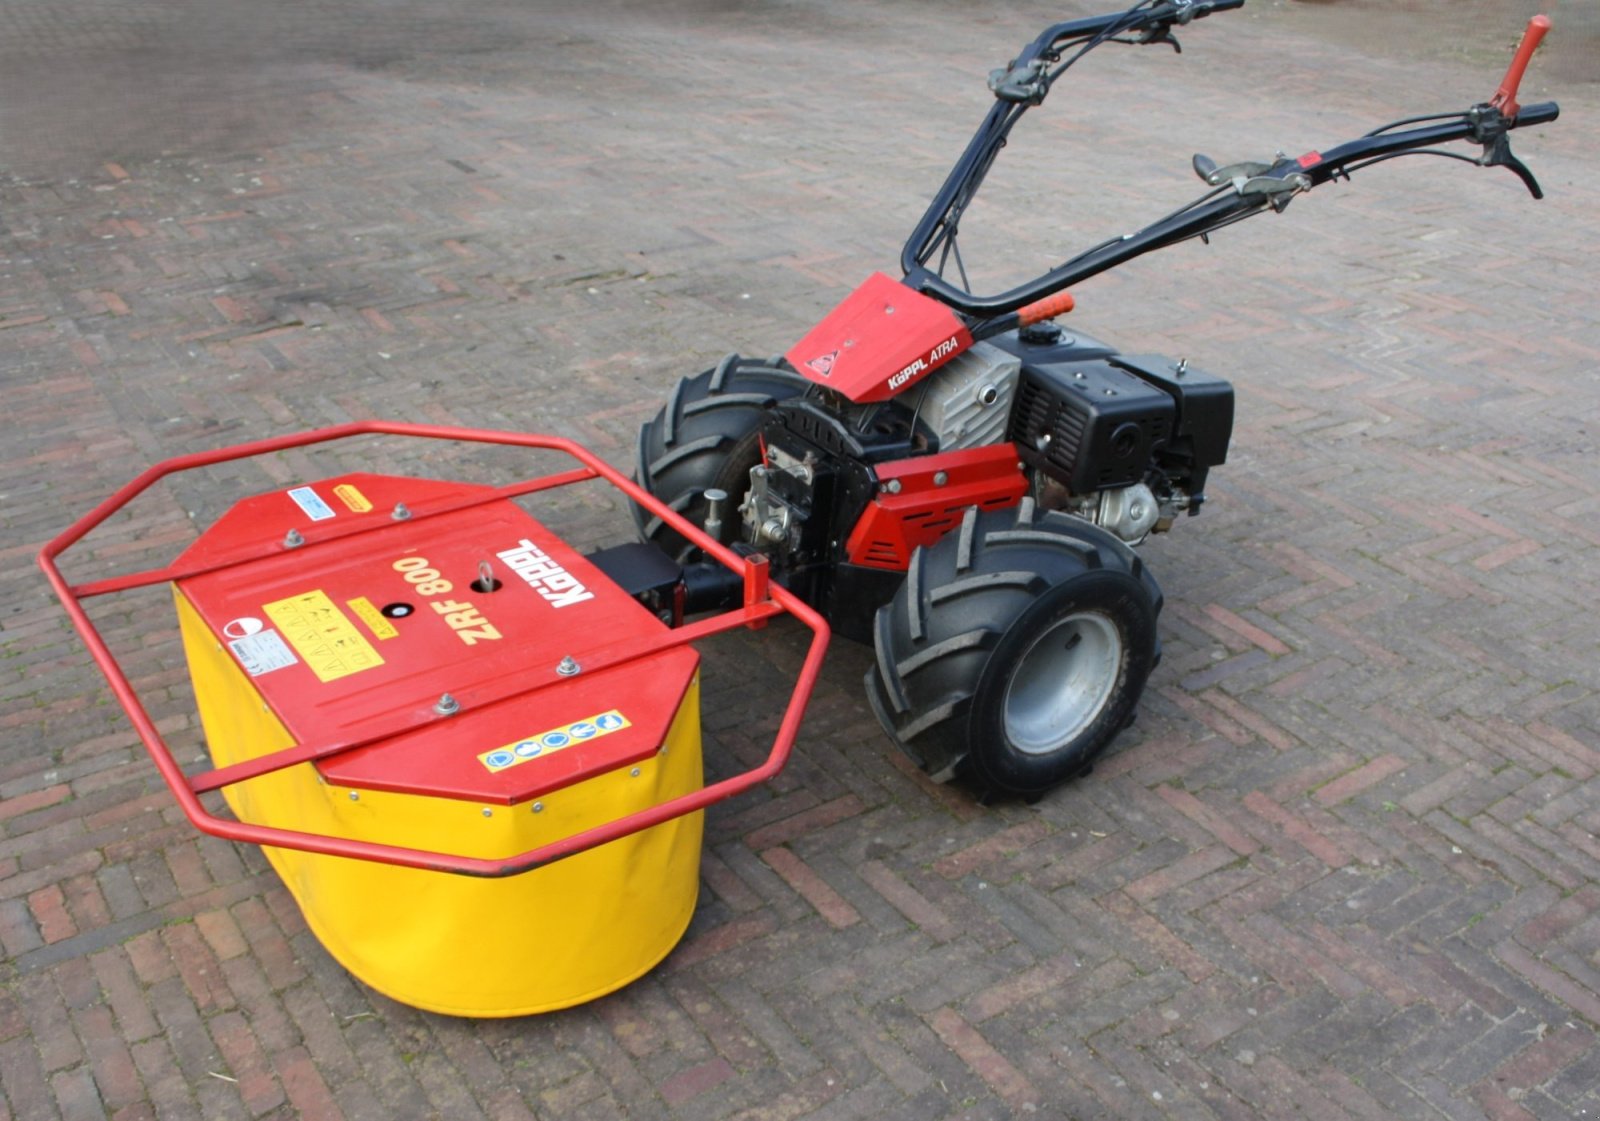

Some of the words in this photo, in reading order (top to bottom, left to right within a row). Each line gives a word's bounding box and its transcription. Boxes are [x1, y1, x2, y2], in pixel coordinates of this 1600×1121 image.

[930, 336, 958, 364] ATRA
[392, 557, 453, 596] 800
[429, 600, 503, 646] ZRF
